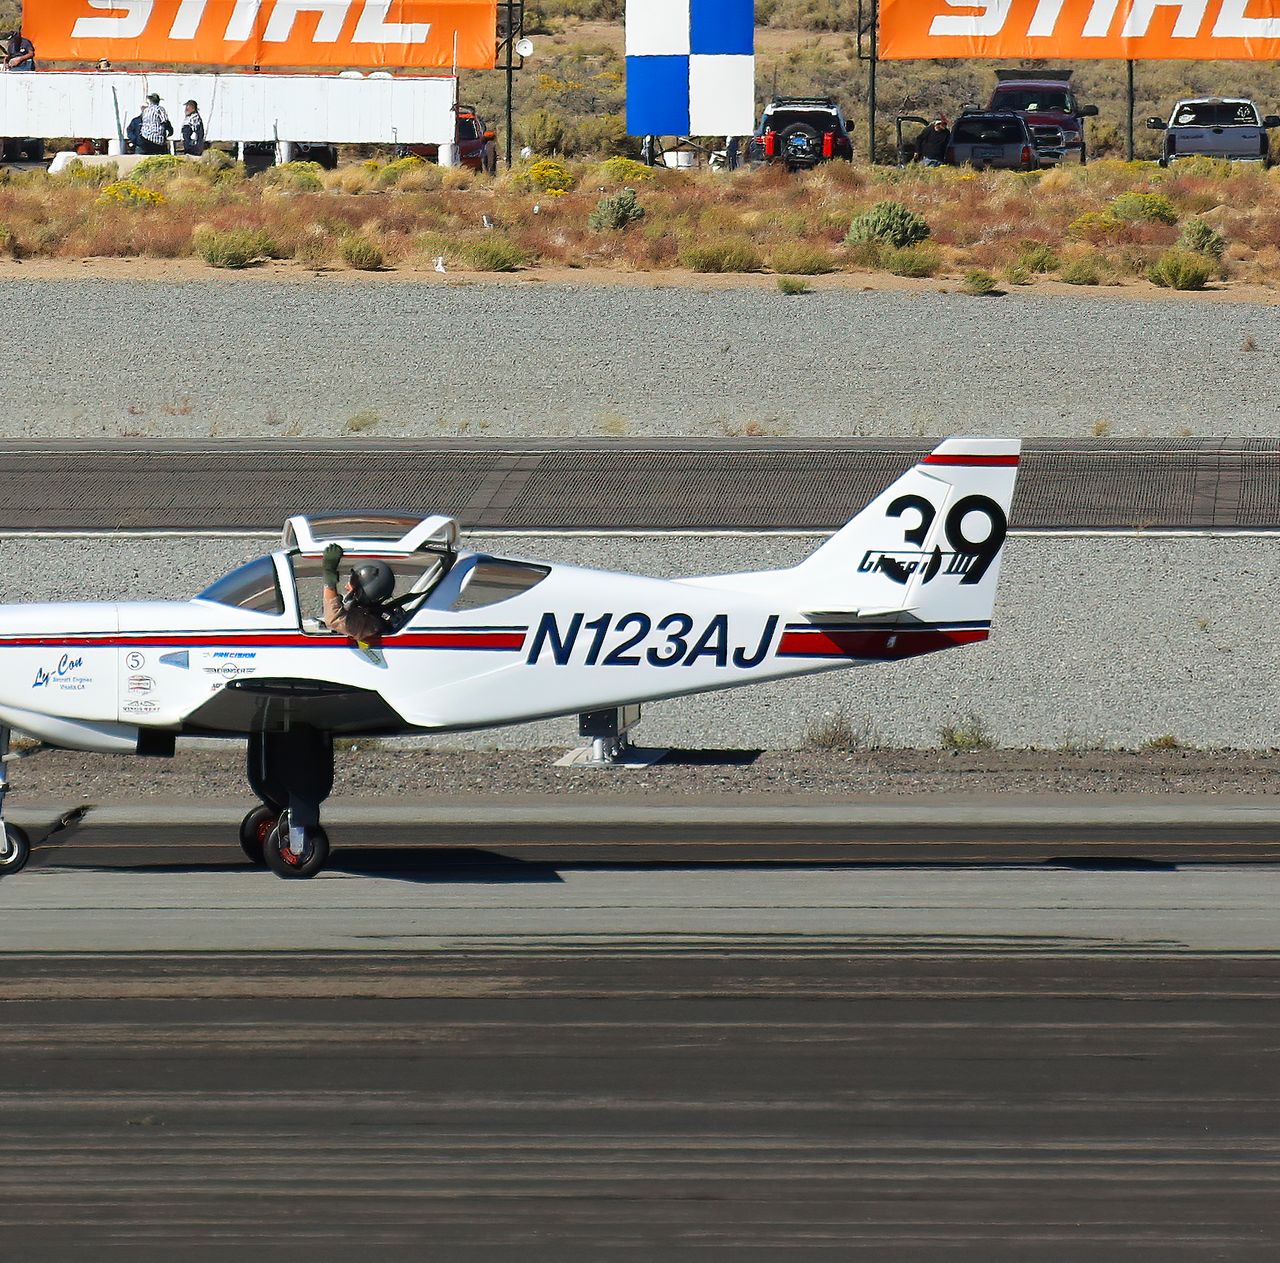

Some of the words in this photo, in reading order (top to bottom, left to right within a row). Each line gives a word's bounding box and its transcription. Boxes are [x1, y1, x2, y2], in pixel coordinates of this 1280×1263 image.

[885, 494, 1008, 586] 39
[130, 654, 140, 669] 5
[526, 612, 781, 669] N123AJ
[31, 653, 83, 688] Ly-Con
